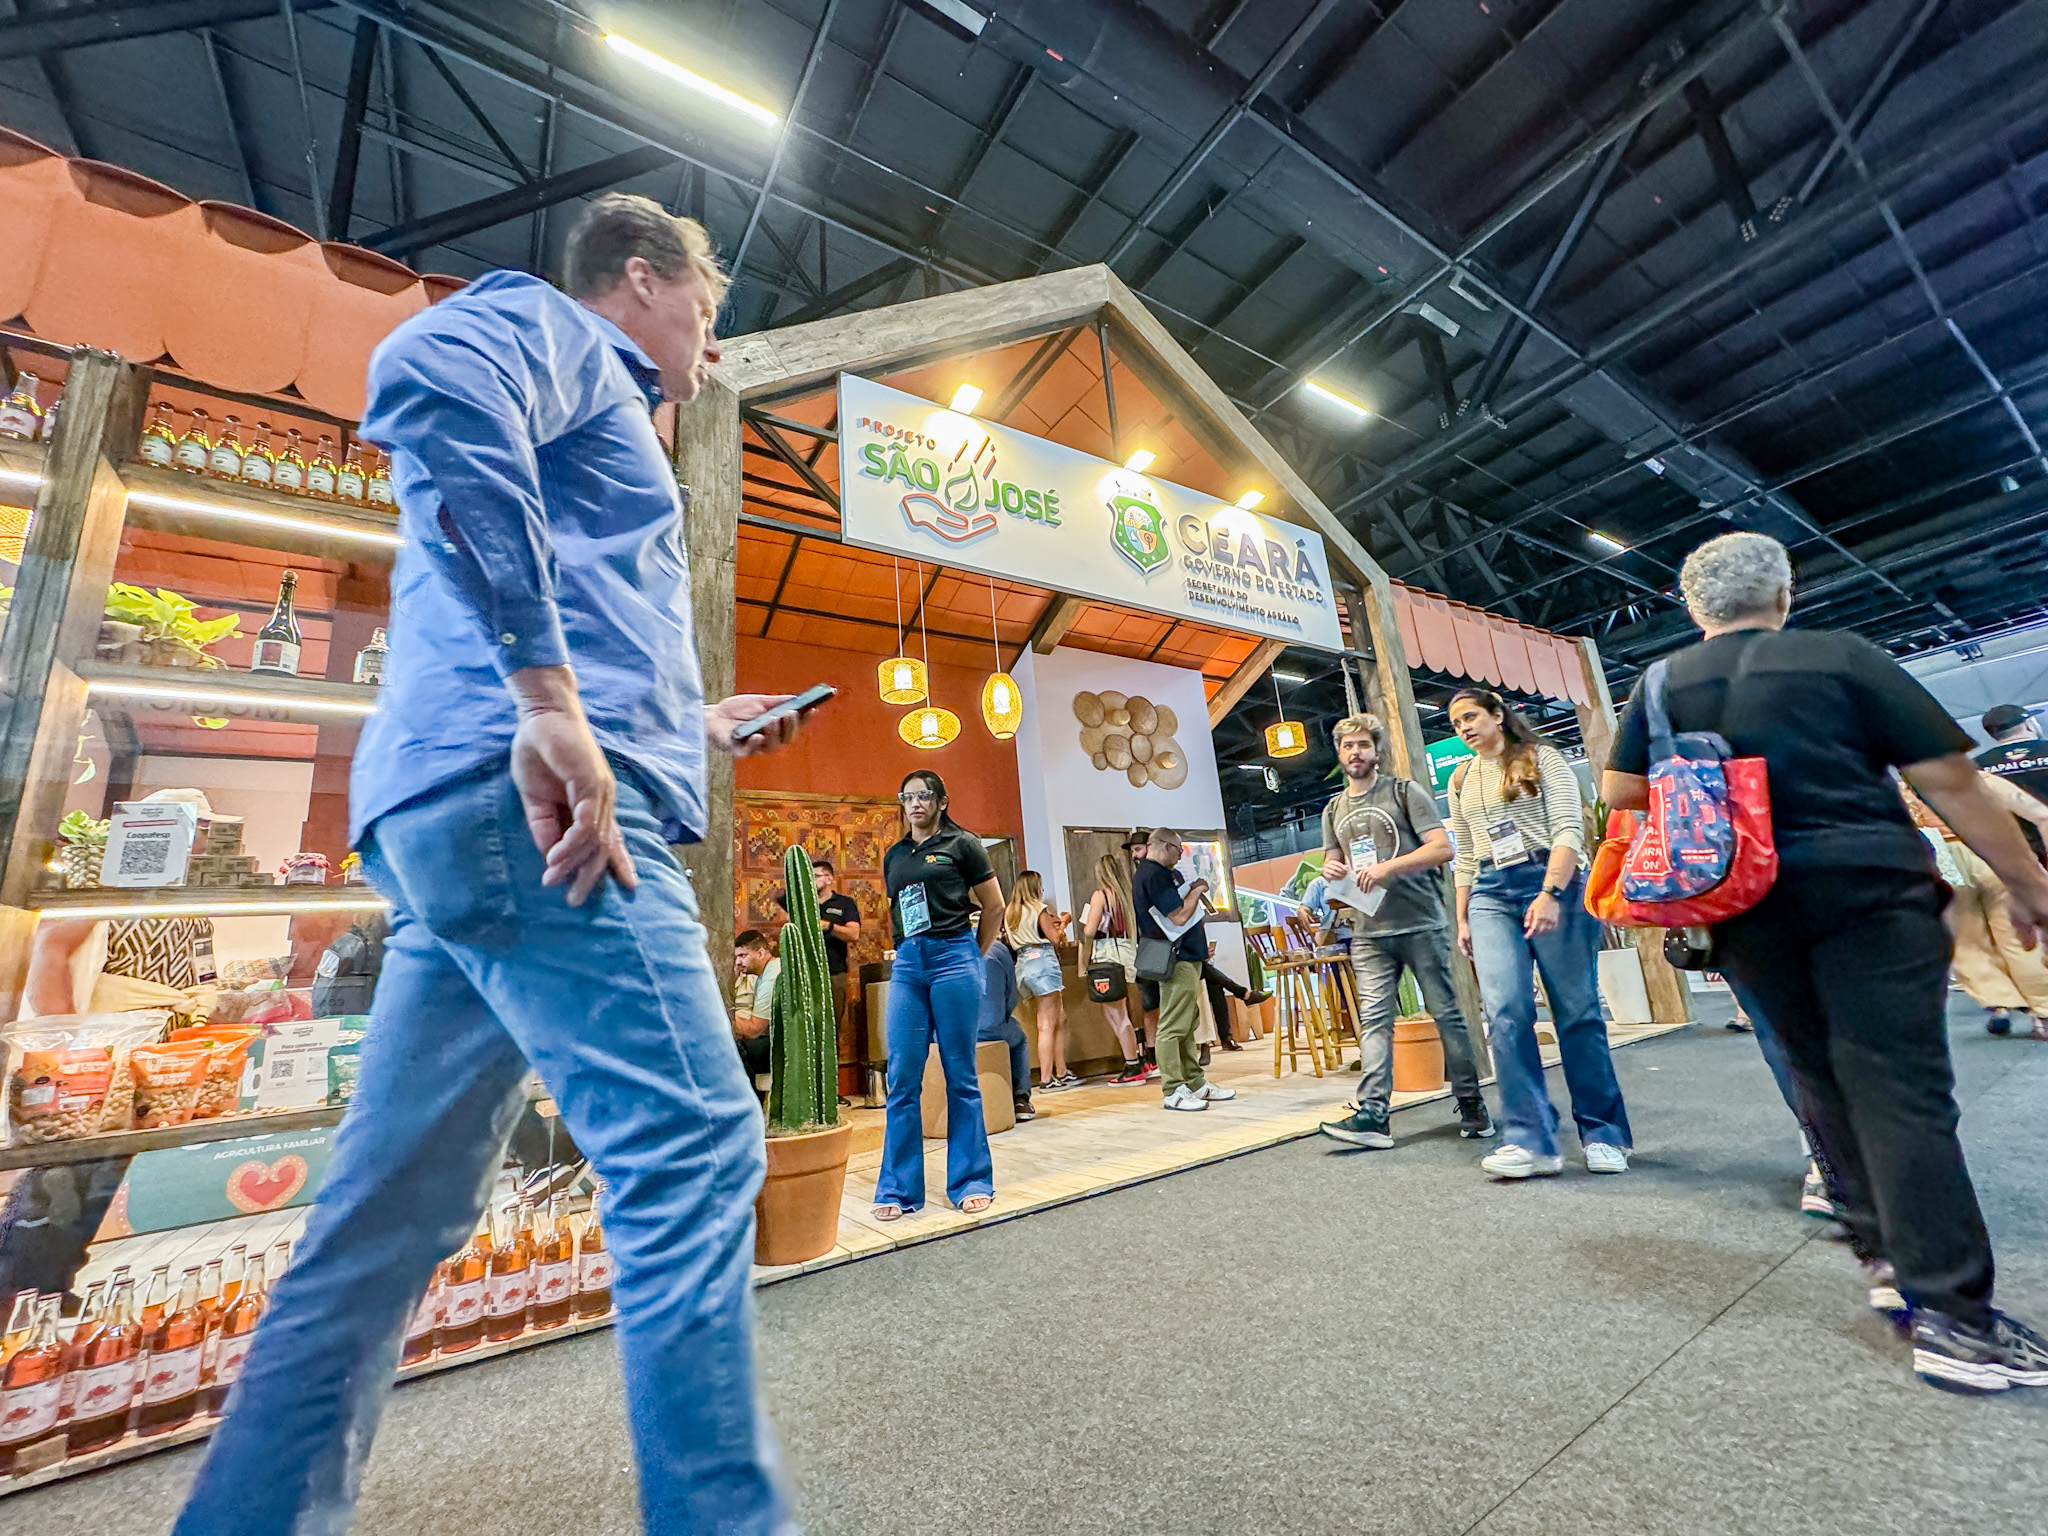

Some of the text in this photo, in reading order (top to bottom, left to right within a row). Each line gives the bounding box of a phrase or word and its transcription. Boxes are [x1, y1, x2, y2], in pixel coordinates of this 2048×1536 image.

[861, 417, 936, 450] PROJETO
[864, 442, 939, 491] SÃO
[985, 478, 1062, 526] JOSÉ
[1178, 514, 1321, 587] CEARÁ
[1183, 555, 1324, 603] GOVERNO DO ESTADO
[1186, 578, 1248, 601] SECRETARIA DO
[1188, 590, 1300, 625] DESENVOLVIMENTO AGRÁRIO
[1643, 860, 1659, 870] ON
[213, 1143, 282, 1160] AGRICULTURA
[283, 1136, 326, 1150] FAMILIAR
